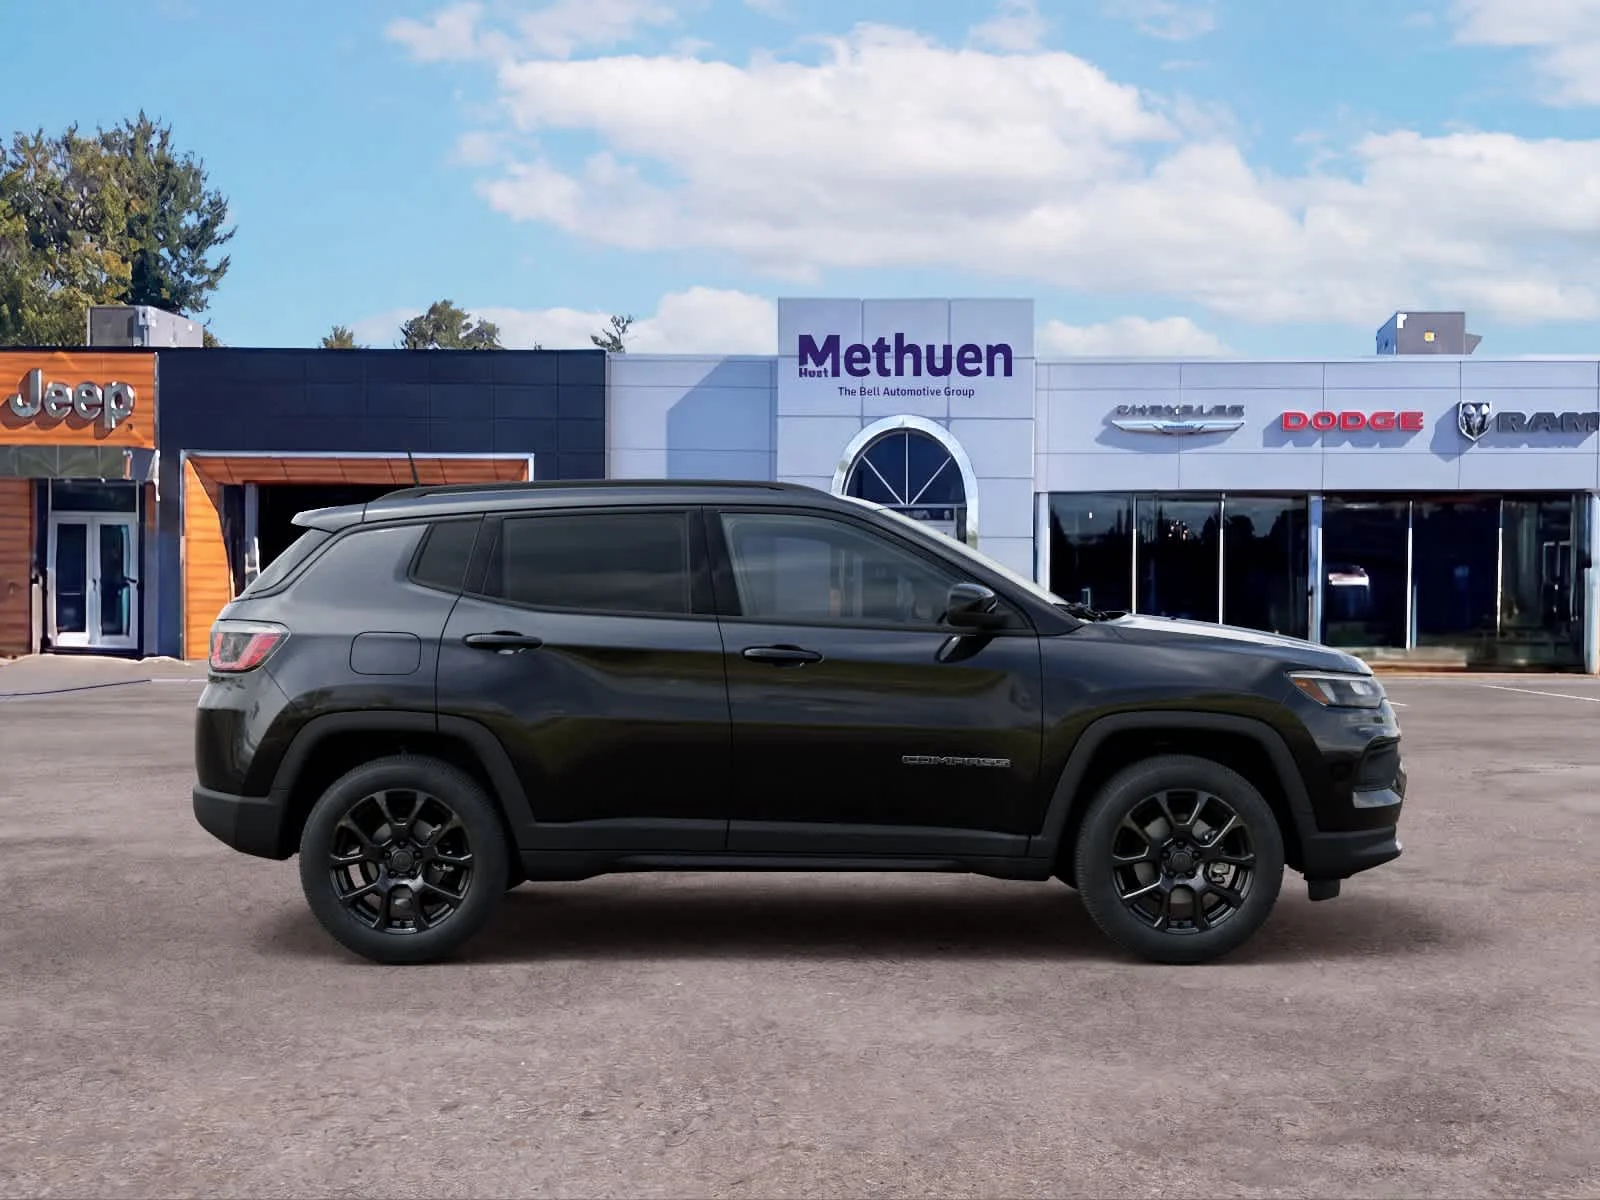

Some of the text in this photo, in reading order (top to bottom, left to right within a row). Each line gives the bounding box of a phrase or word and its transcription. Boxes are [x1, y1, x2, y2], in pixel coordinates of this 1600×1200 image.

[799, 333, 1013, 378] Methuen
[8, 368, 135, 429] Jeep
[838, 386, 975, 399] The Bell Automotive Group
[1282, 411, 1424, 432] DODGE
[1497, 412, 1600, 433] RAM
